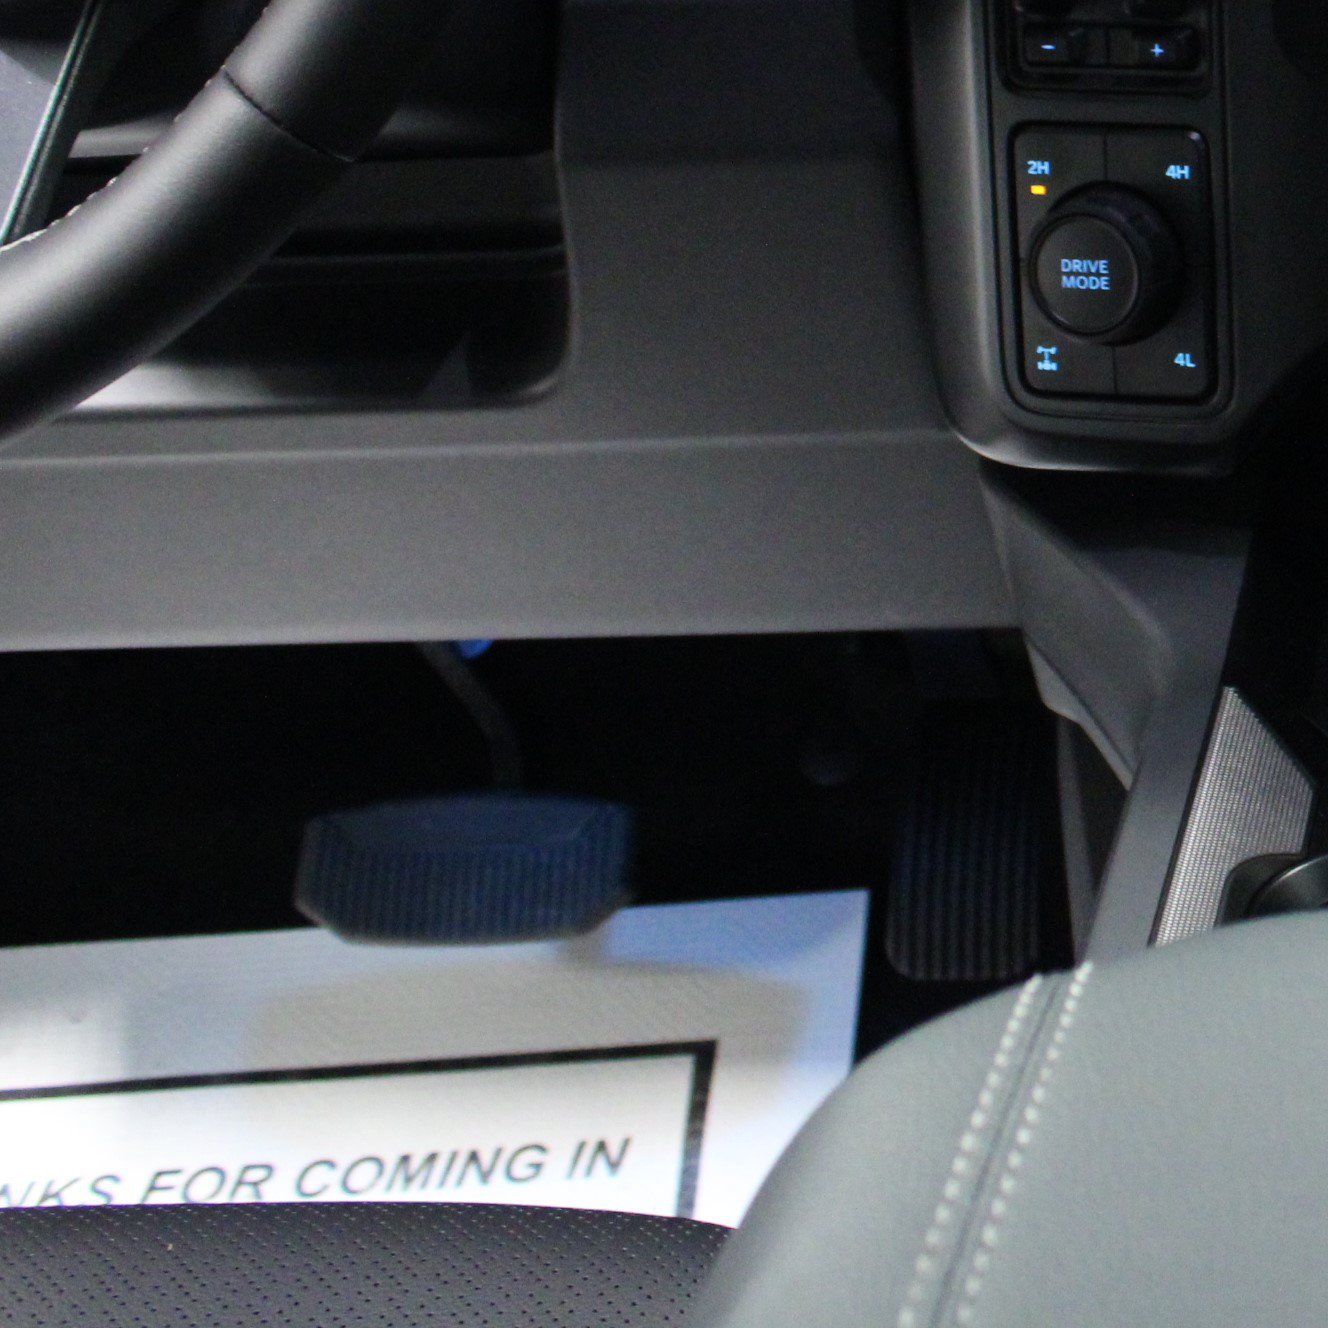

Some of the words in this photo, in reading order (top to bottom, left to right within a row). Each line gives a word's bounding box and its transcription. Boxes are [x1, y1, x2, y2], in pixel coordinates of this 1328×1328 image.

[1027, 160, 1050, 175] 2H
[1165, 164, 1190, 180] 4H
[1060, 258, 1110, 275] DRIVE
[1061, 275, 1110, 291] MODE
[1173, 352, 1196, 368] 4L
[140, 1163, 274, 1205] FOR
[295, 1143, 548, 1199] COMING
[565, 1136, 631, 1178] IN
